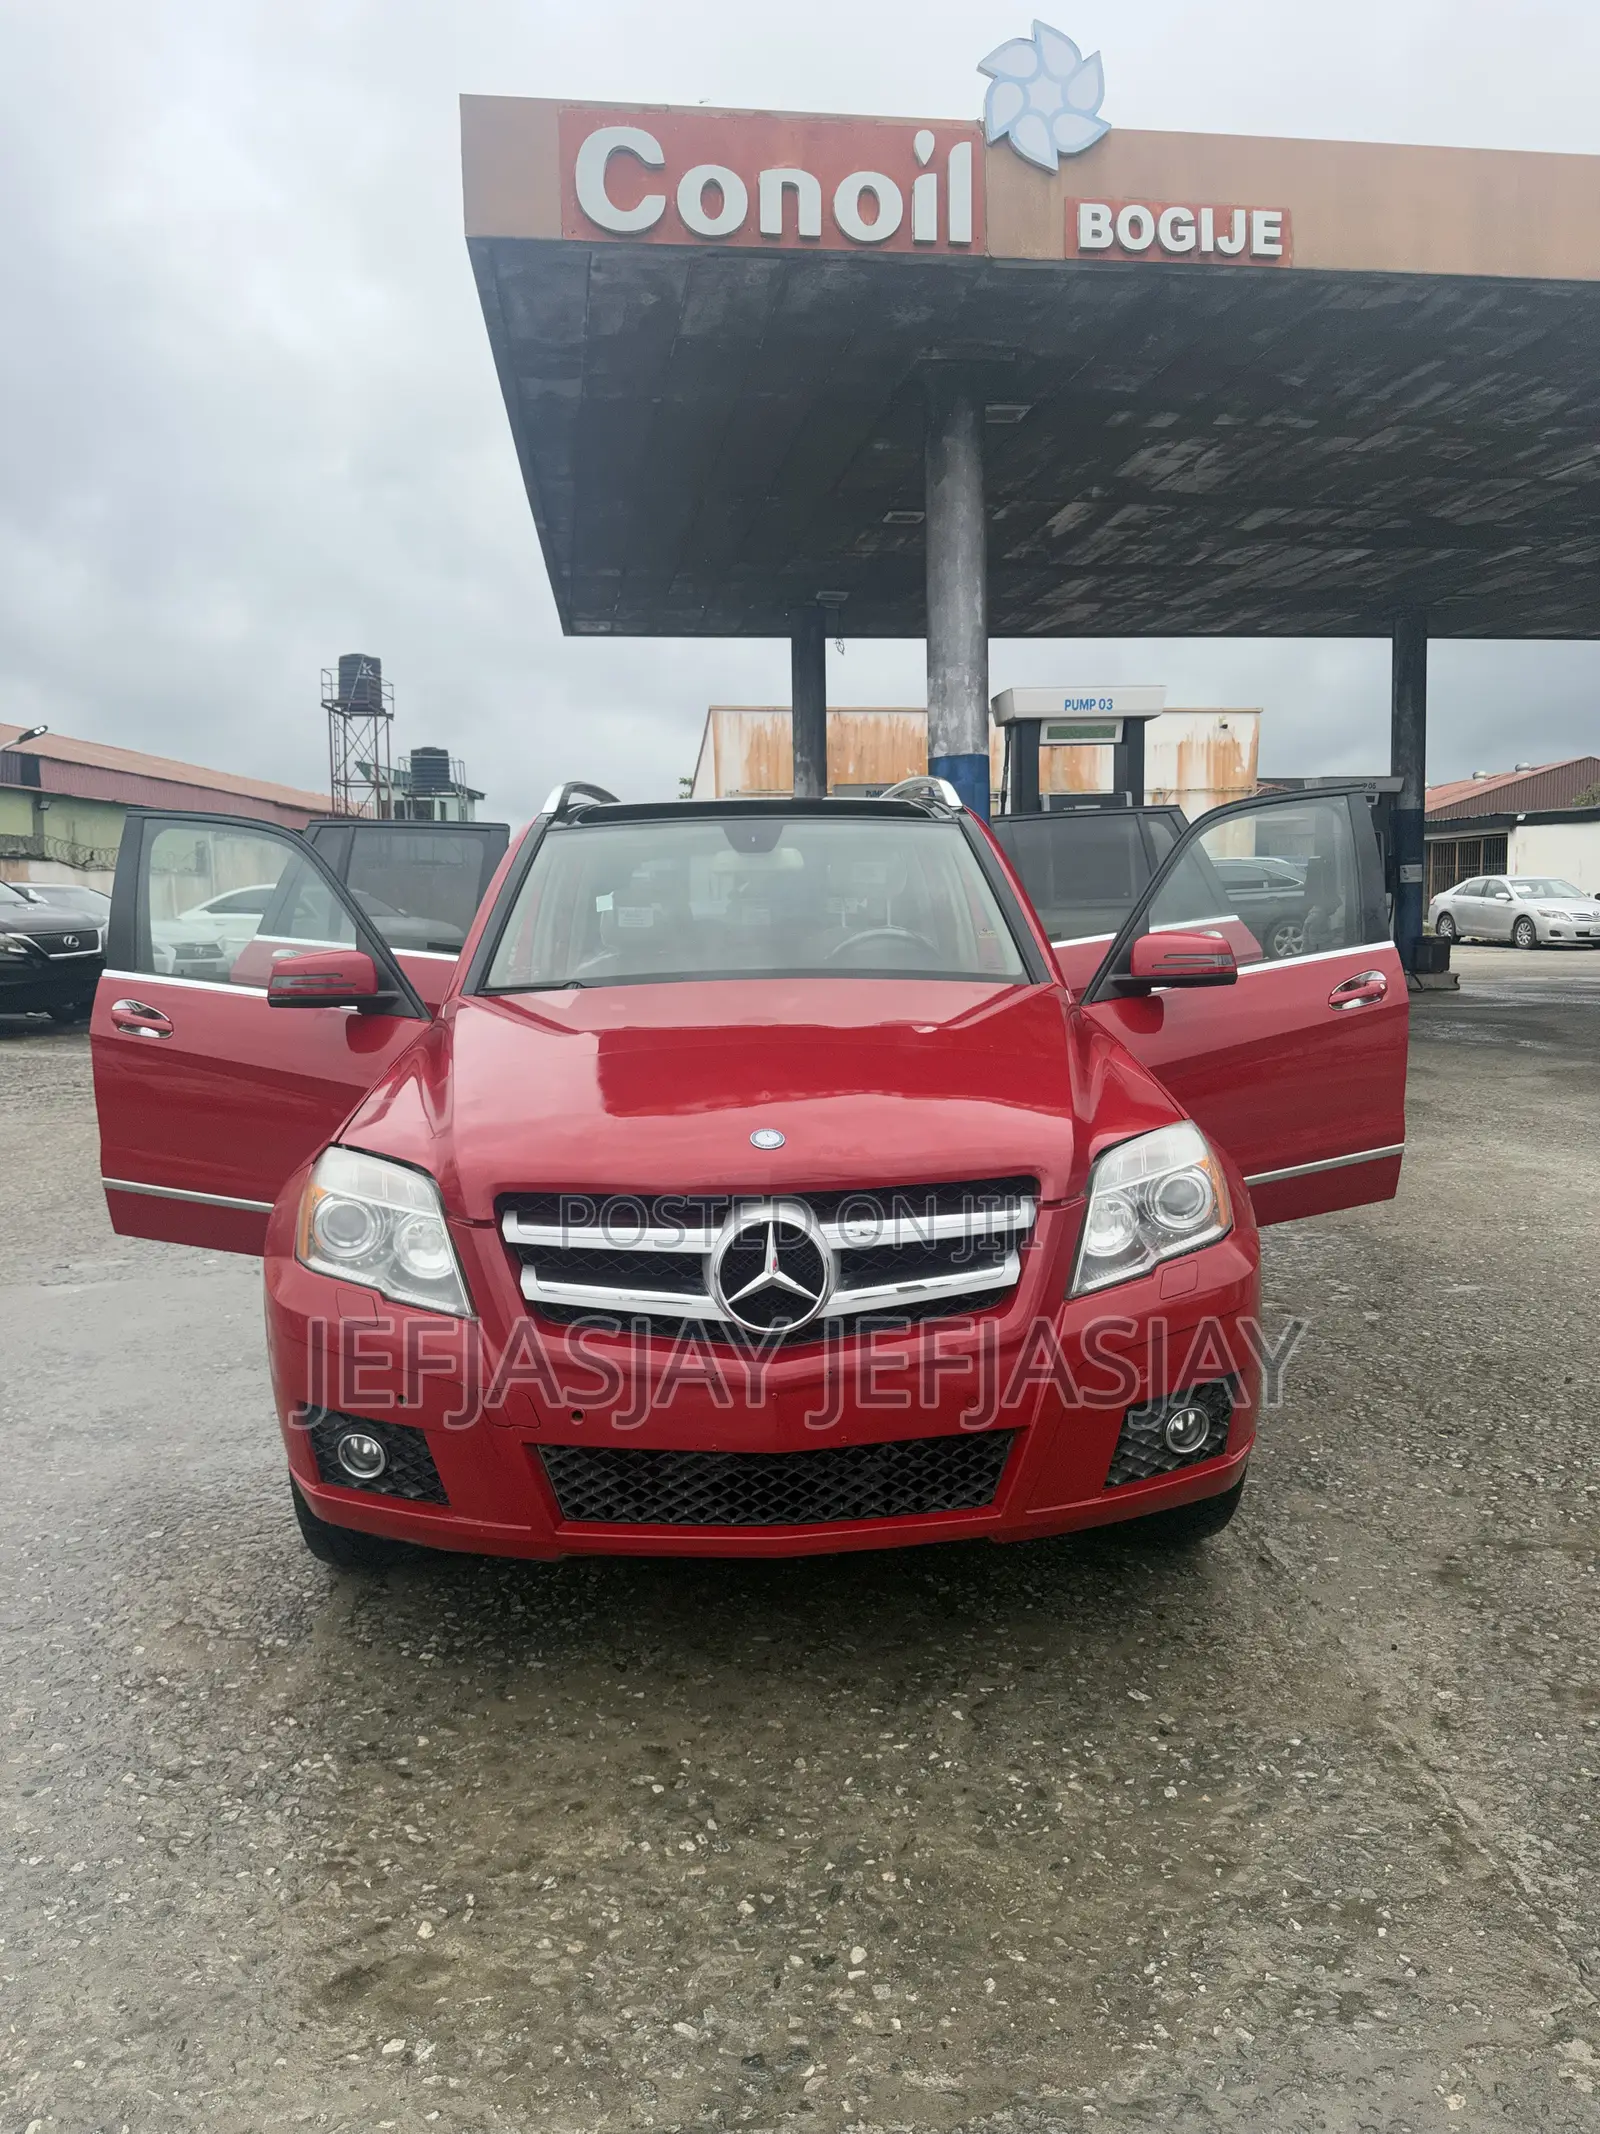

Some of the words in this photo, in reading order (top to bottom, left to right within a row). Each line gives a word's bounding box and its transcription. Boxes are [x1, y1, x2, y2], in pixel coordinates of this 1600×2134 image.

[574, 125, 972, 246] Conoil
[1077, 202, 1284, 257] BOGIJE
[1064, 698, 1097, 711] PUMP
[1098, 698, 1114, 711] 03
[1367, 782, 1377, 790] 05
